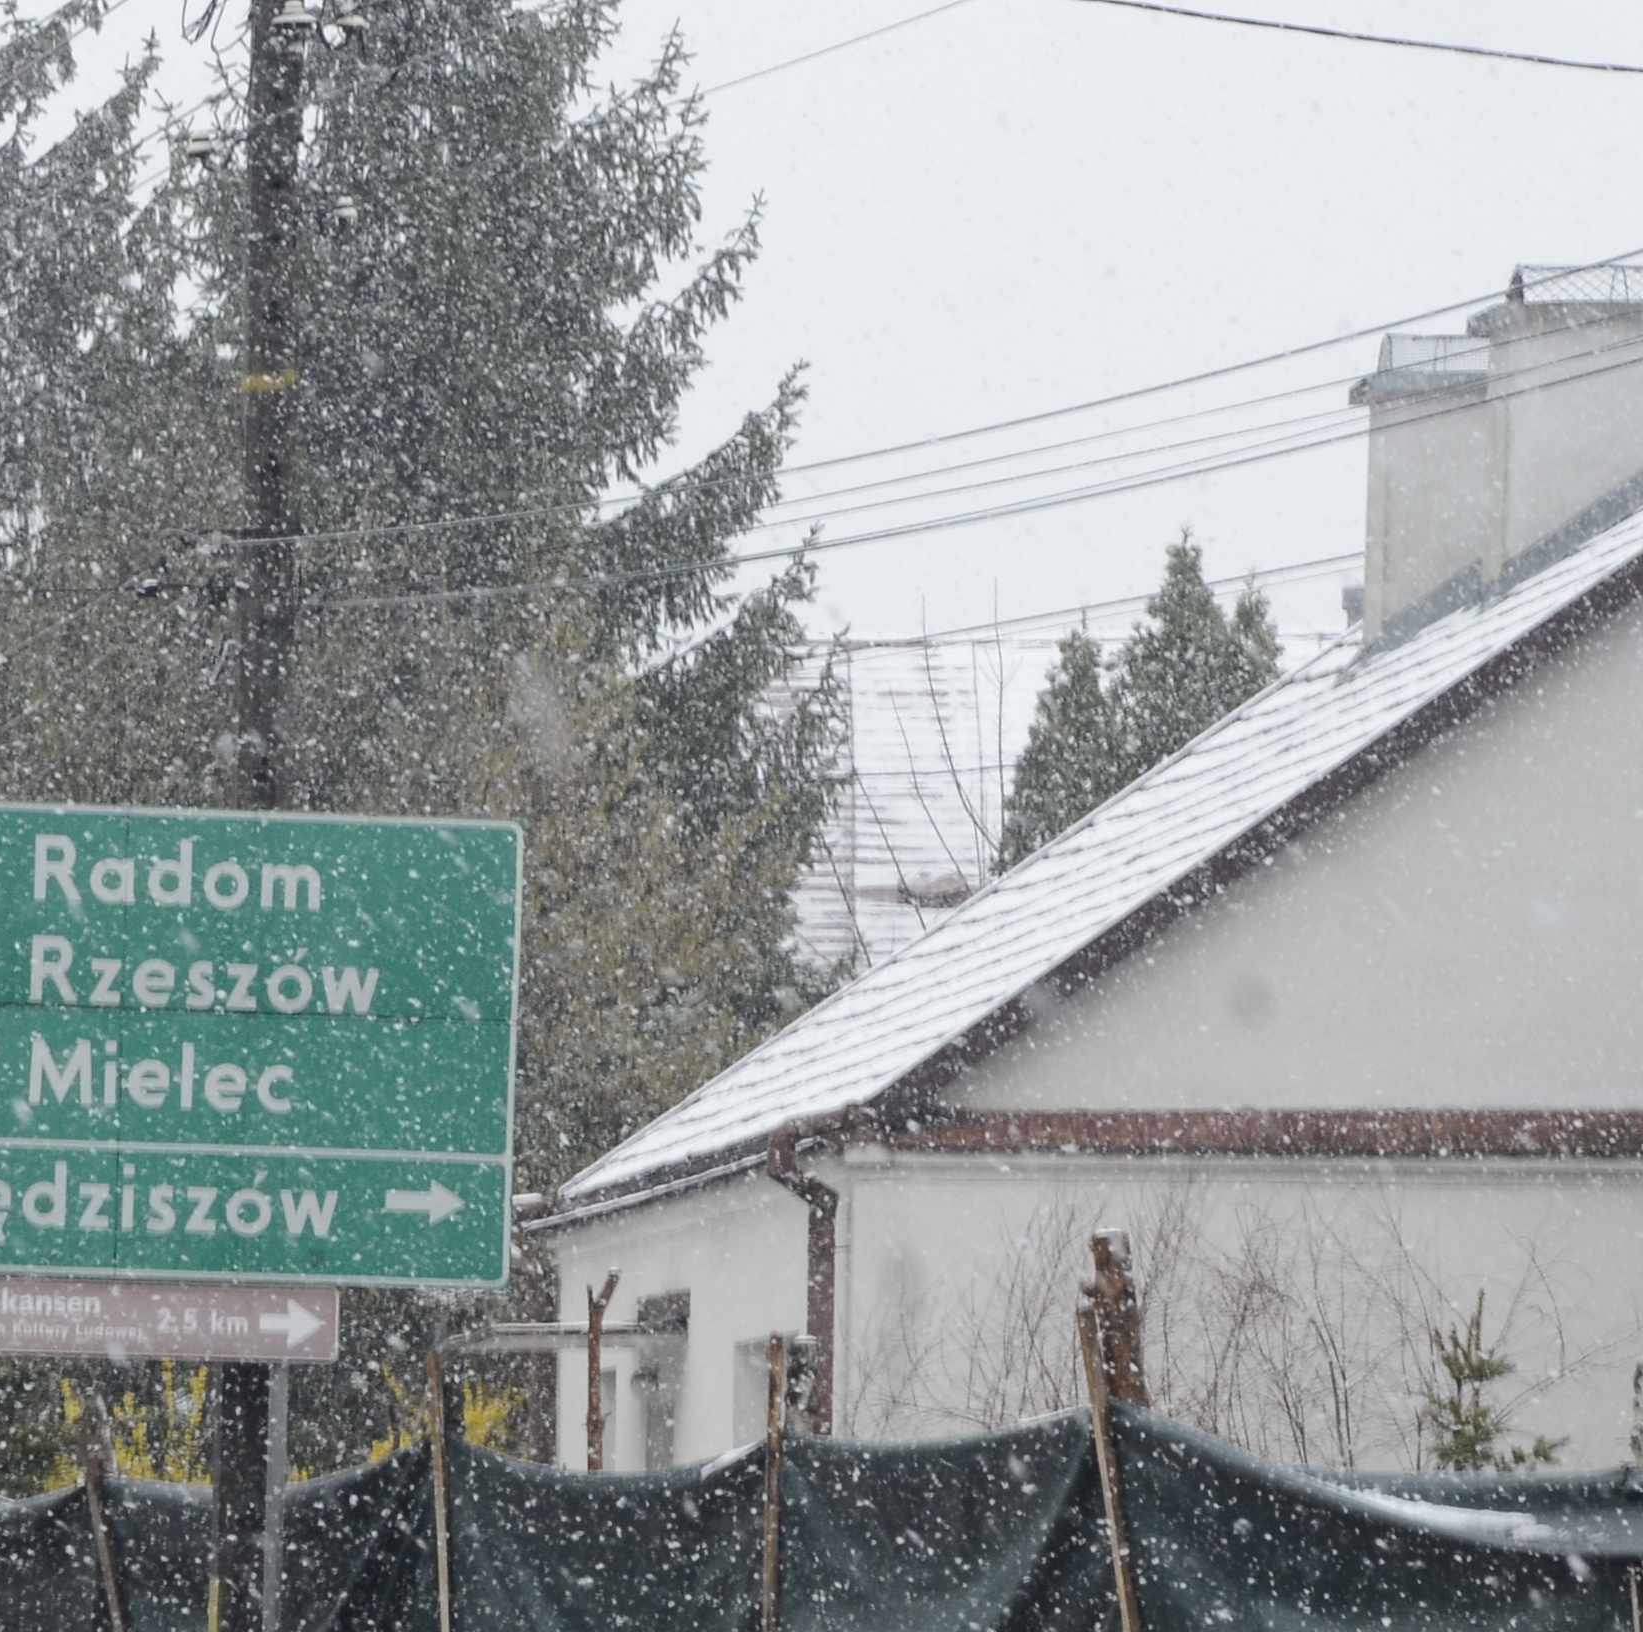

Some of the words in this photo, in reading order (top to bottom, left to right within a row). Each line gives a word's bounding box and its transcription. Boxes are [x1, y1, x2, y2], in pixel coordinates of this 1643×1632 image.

[32, 833, 323, 912] Radom
[29, 934, 379, 1015] Rzeszów
[28, 1038, 293, 1114] Mielec
[211, 1309, 249, 1336] km
